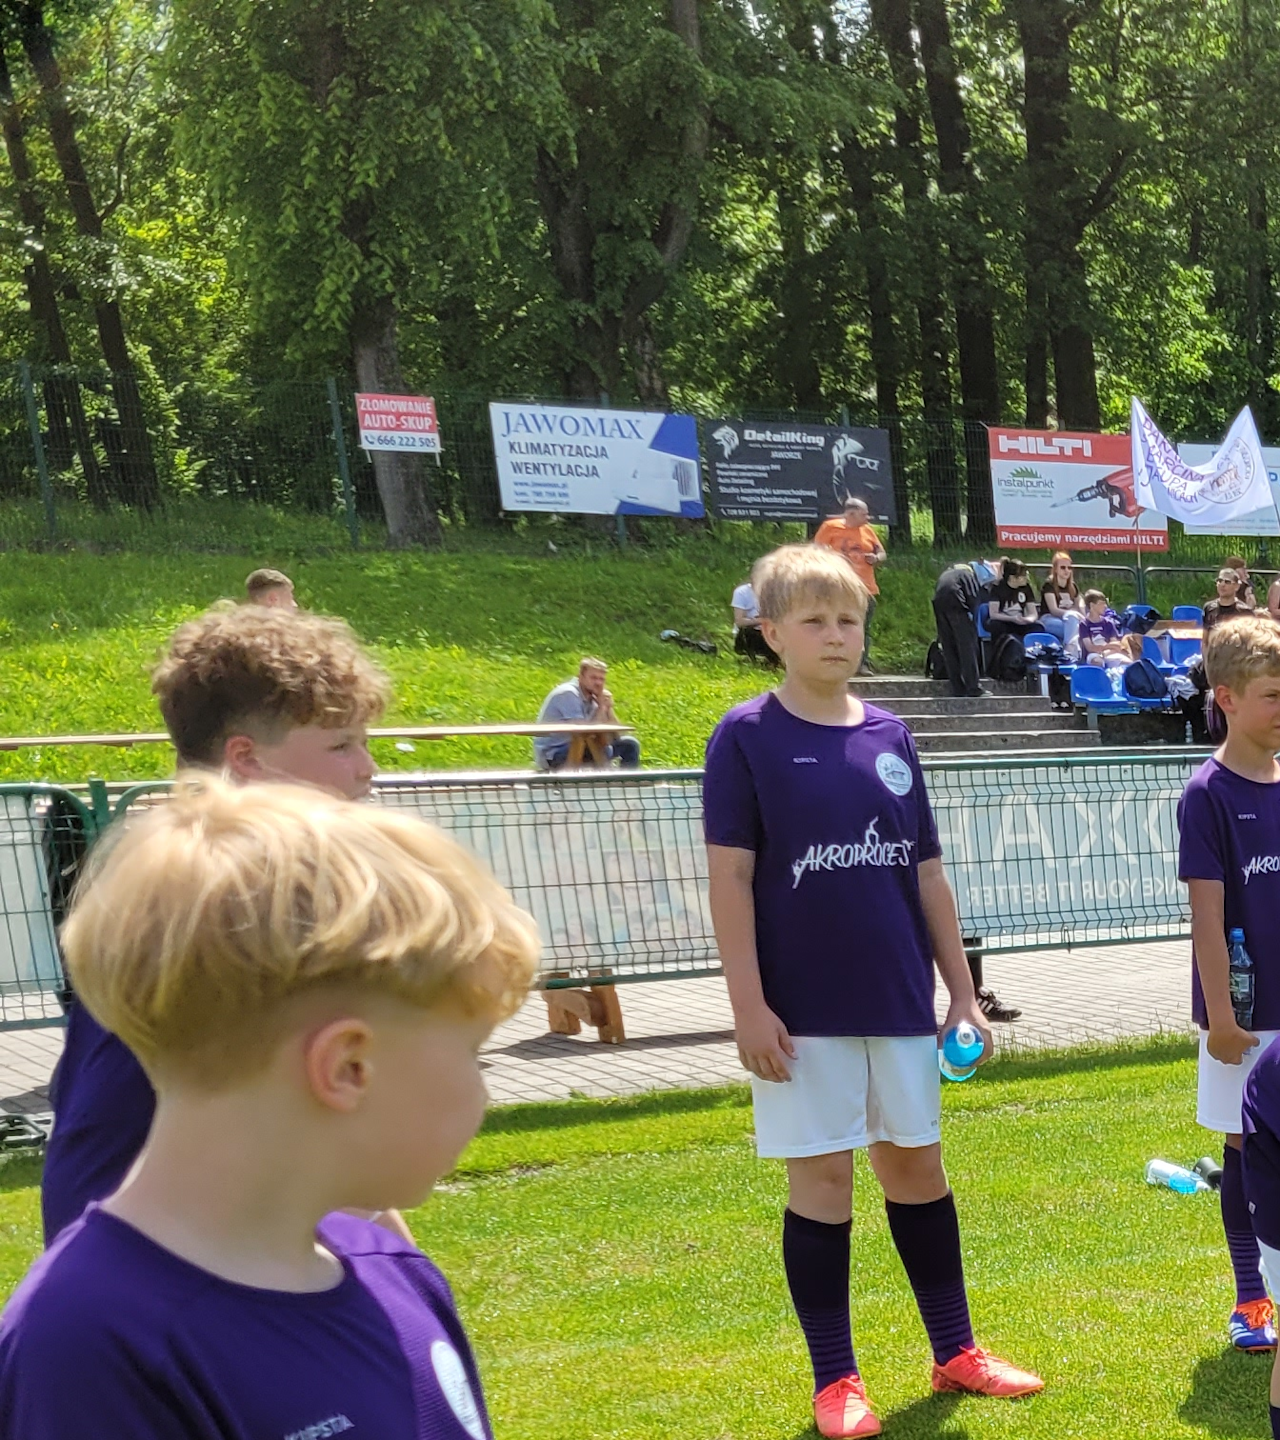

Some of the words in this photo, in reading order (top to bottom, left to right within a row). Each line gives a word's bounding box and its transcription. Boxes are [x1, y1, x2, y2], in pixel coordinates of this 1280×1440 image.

[363, 413, 433, 430] AUTO-SKUP
[502, 411, 645, 440] JAWOMAX
[377, 435, 396, 446] 666
[398, 436, 416, 447] 222
[743, 429, 825, 447] DetailKing
[998, 435, 1093, 458] HILTI
[508, 440, 610, 460] KLIMATYZACJA
[510, 460, 600, 479] WENTYLACJA
[1000, 531, 1062, 543] Pracujemy
[1065, 533, 1131, 545] narzędziami
